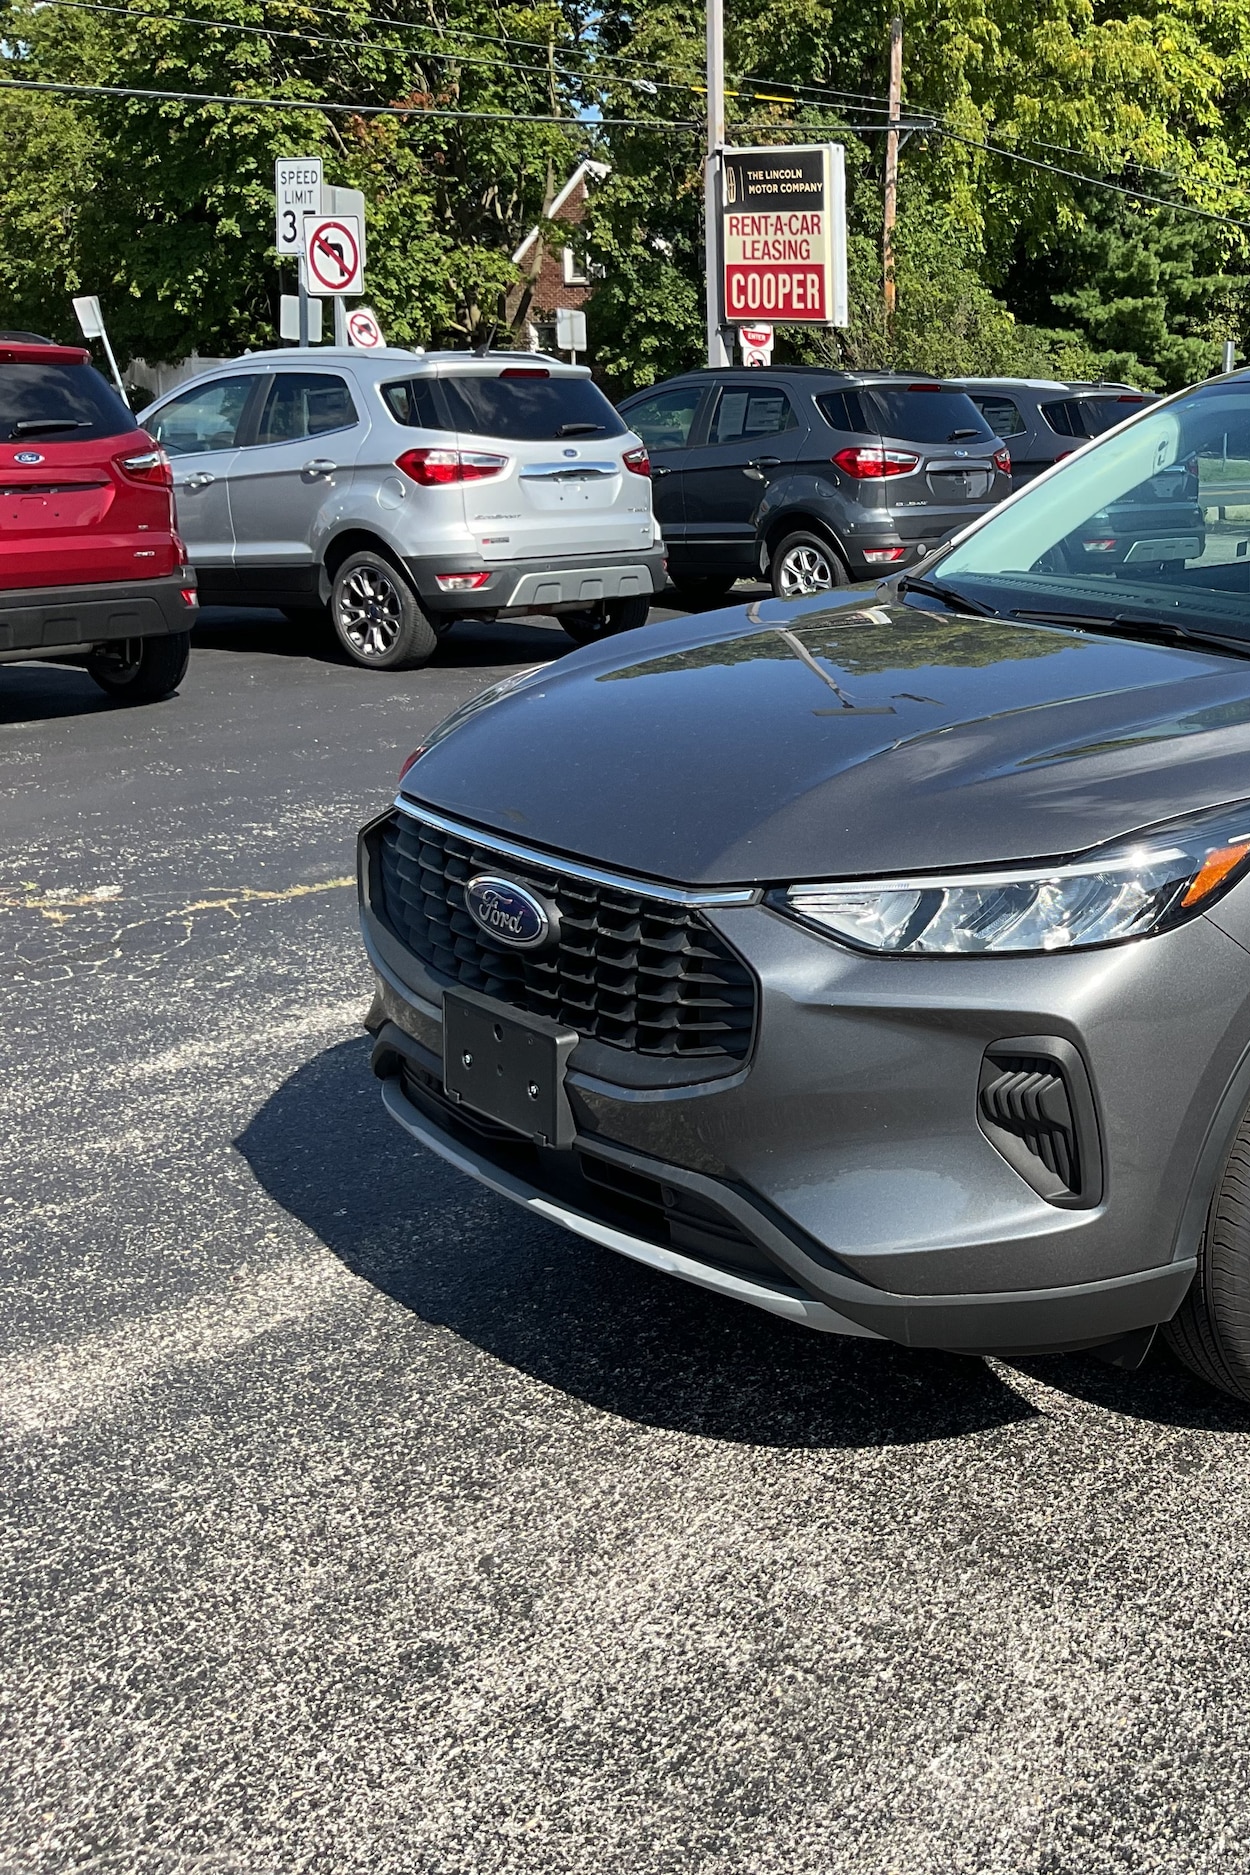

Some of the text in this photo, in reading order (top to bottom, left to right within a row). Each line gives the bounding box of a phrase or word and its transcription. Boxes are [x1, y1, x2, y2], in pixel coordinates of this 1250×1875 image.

[280, 170, 318, 185] SPEED
[747, 169, 803, 180] THE LINCOLN
[284, 190, 314, 204] LIMIT
[748, 183, 823, 194] MOTOR COMPANY
[282, 210, 316, 243] 3
[729, 214, 821, 236] RENT-A-CAR
[742, 239, 811, 261] LEASING
[731, 273, 820, 310] COOPER
[747, 332, 767, 342] ENTER
[478, 889, 523, 934] Ford
